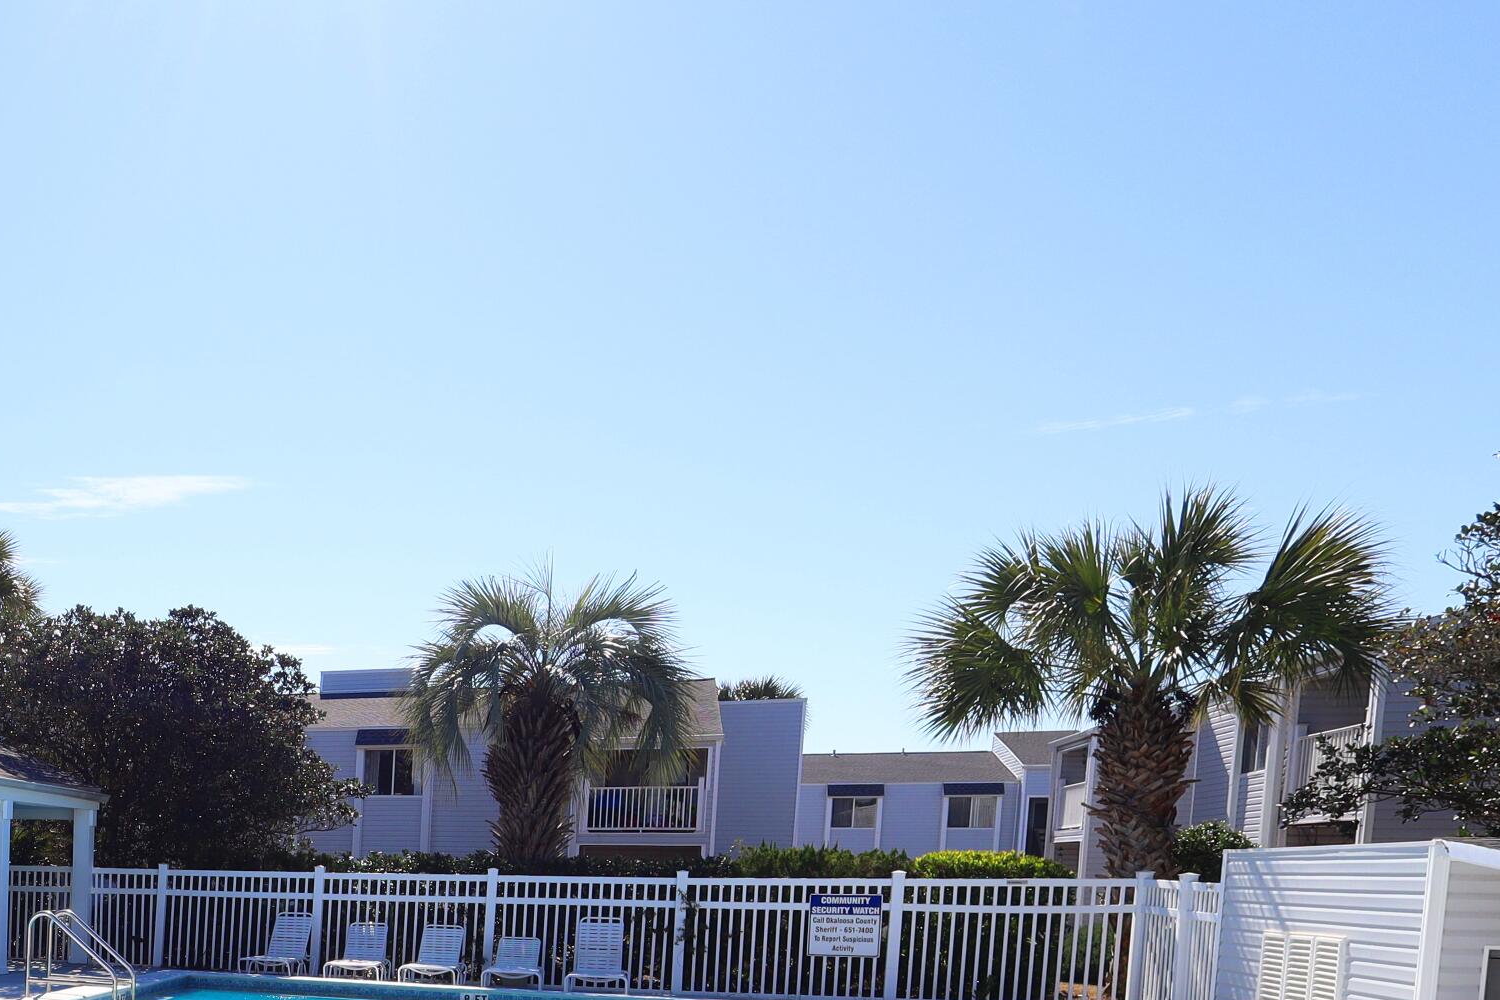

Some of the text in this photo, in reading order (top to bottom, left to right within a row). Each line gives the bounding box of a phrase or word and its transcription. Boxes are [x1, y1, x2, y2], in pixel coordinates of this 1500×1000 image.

[821, 896, 871, 904] COMMUNITY
[811, 906, 880, 914] SECURITY WATCH
[855, 917, 877, 925] County
[821, 935, 841, 943] Report
